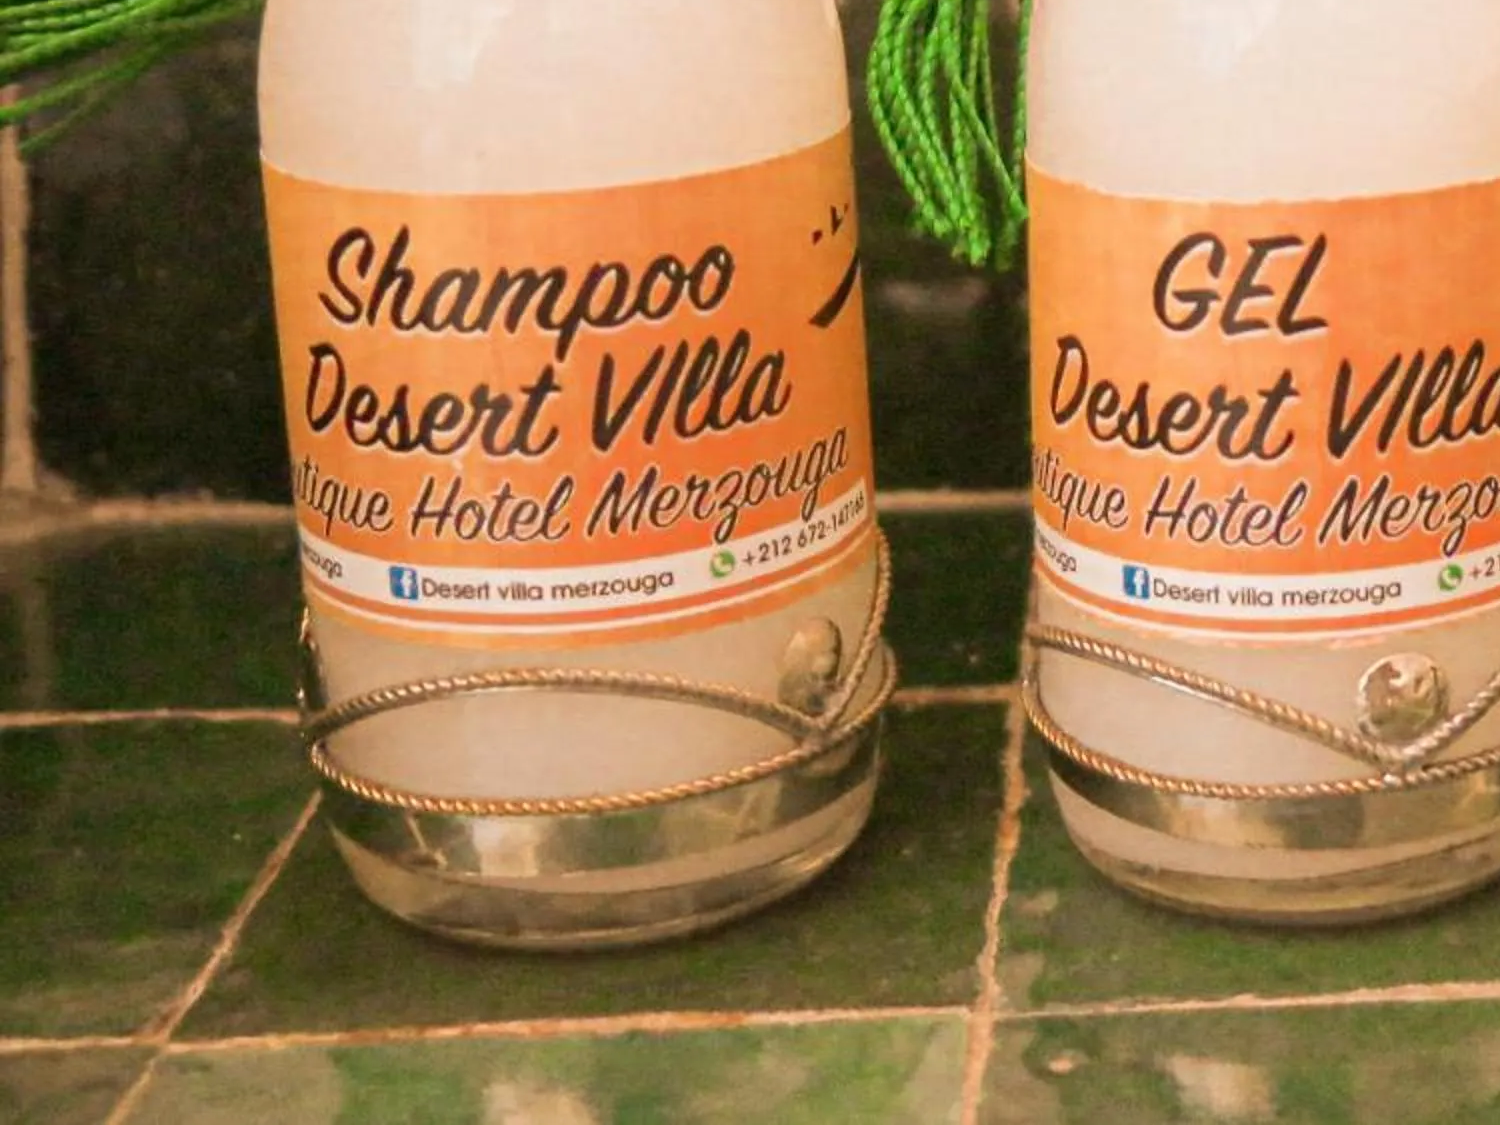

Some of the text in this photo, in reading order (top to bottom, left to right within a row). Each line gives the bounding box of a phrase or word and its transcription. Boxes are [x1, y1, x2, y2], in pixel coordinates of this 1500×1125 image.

[318, 224, 736, 363] Shampoo
[1152, 231, 1330, 337] GEL
[304, 343, 562, 457] Desert
[1050, 335, 1301, 462] Desert
[410, 475, 571, 543] Hotel
[586, 426, 849, 544] Merzouga
[1143, 474, 1310, 547] Hotel
[421, 576, 490, 601] Desert
[496, 582, 544, 602] villa
[551, 570, 675, 601] merzouga
[743, 535, 793, 566] +212
[1152, 577, 1220, 605] Desert
[1227, 586, 1274, 607] villa
[1281, 581, 1402, 607] merzouga
